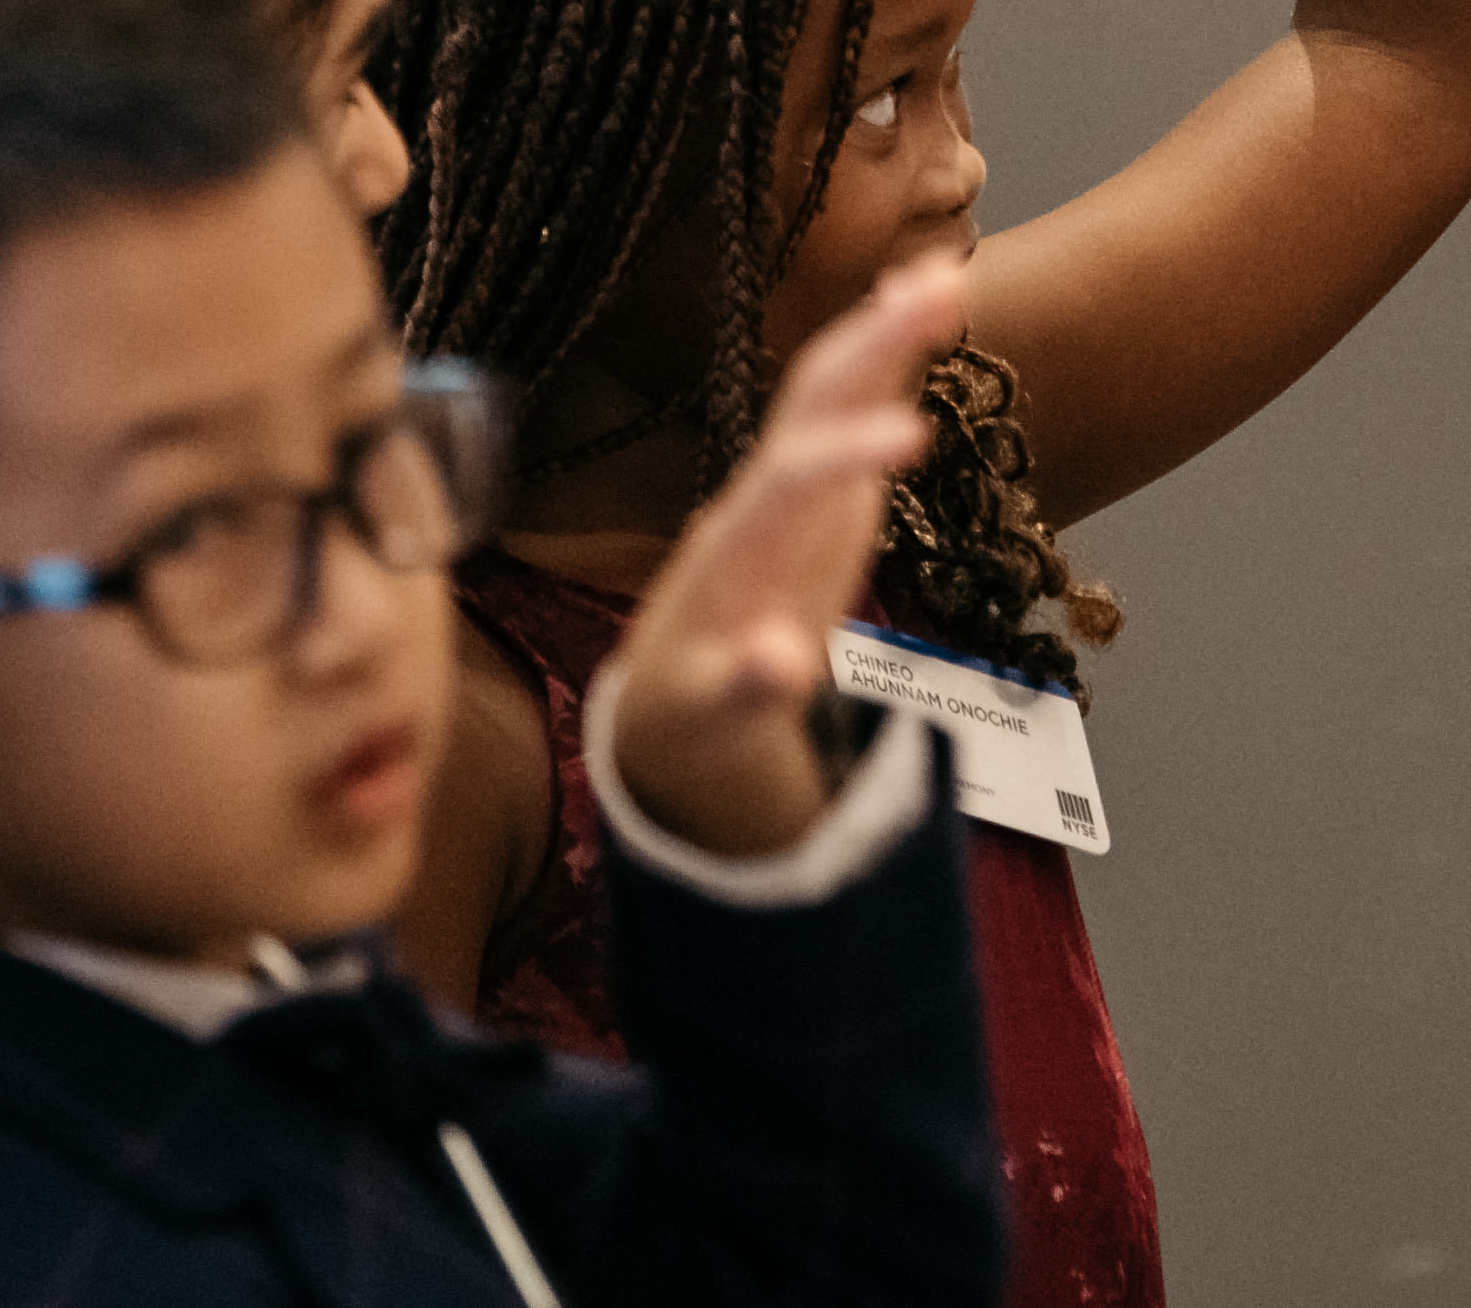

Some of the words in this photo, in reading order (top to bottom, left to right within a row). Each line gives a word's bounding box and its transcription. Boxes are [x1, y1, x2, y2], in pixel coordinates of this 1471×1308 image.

[845, 648, 914, 683] CHINEO
[851, 669, 943, 711] AHUNNAM
[947, 697, 1030, 737] ONOCHIE
[1061, 817, 1098, 840] NYSE
